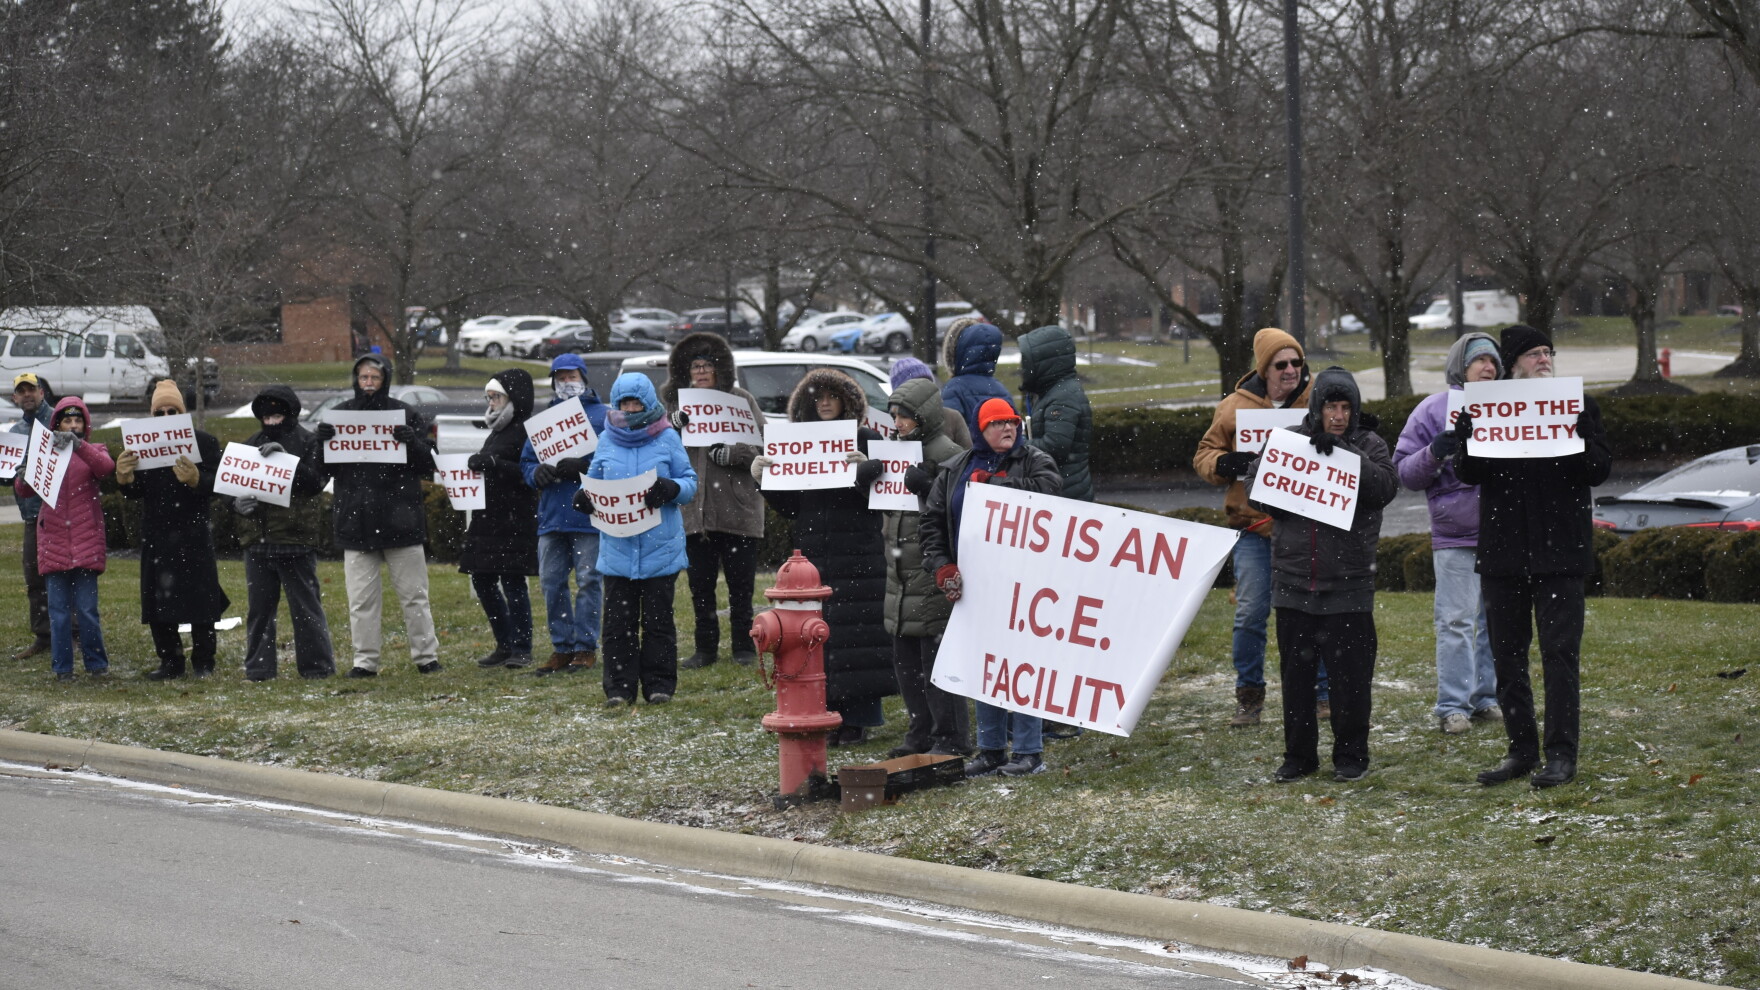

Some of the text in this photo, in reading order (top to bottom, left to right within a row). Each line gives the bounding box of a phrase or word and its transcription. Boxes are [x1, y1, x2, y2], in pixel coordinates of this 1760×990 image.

[682, 404, 753, 420] STOP THE
[1468, 402, 1527, 418] STOP
[1535, 399, 1580, 416] THE
[125, 428, 193, 445] STOP THE
[335, 424, 400, 435] TOP TH
[531, 412, 586, 447] STOP THE
[686, 422, 754, 434] CRUELTY
[1473, 423, 1578, 442] CRUELTY
[329, 440, 401, 451] CRUELTY
[539, 429, 588, 462] CRUELTY
[767, 439, 854, 456] STOP THE
[33, 429, 51, 490] STOP THE
[223, 456, 292, 480] STOP THE
[769, 460, 851, 476] CRUELTY
[881, 460, 910, 473] TOP
[450, 470, 481, 481] THE
[1266, 448, 1357, 490] STOP THE
[221, 472, 287, 495] CRUELTY
[446, 486, 479, 498] ELTY
[875, 480, 912, 495] CRUE
[1263, 471, 1351, 511] CRUELTY
[626, 487, 652, 505] TH
[985, 500, 1189, 580] THIS IS AN
[1008, 581, 1111, 651] I.C.E.
